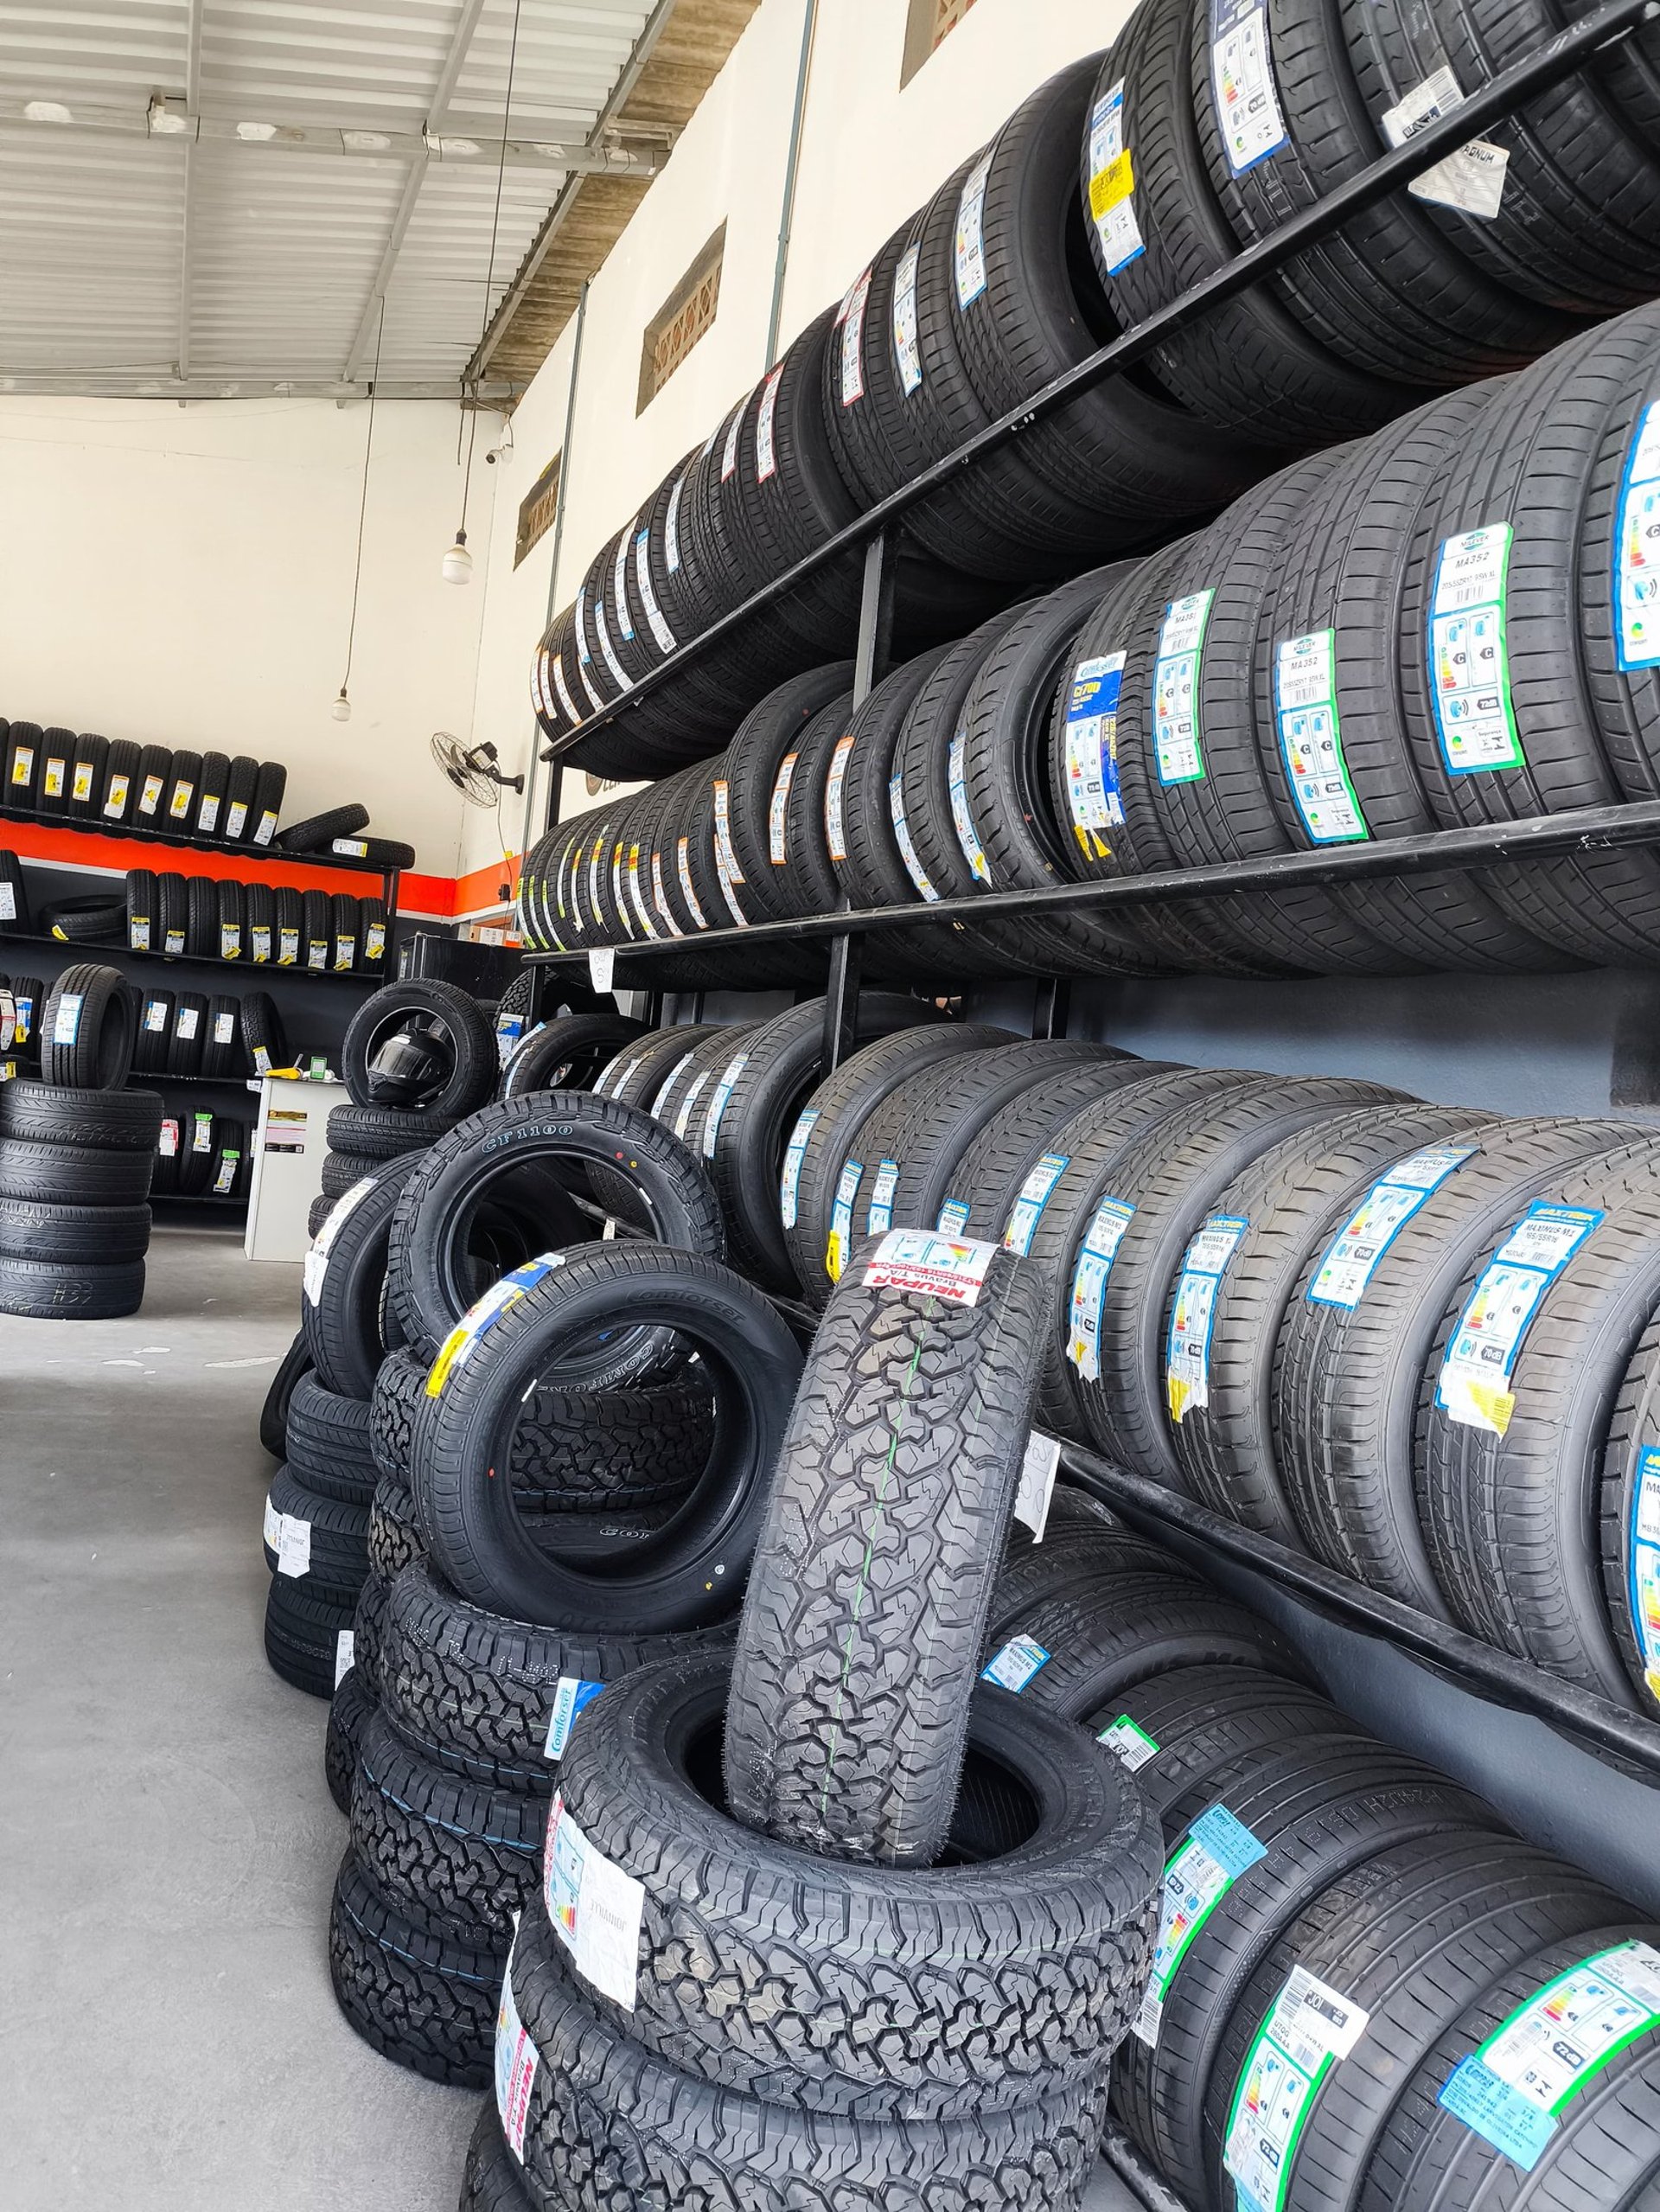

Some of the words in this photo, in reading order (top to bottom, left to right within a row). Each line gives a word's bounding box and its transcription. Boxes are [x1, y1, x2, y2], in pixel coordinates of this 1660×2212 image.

[1455, 552, 1490, 568] MA352
[1291, 657, 1318, 670] MA352
[482, 1124, 573, 1153] CF1100
[890, 1269, 910, 1278] T/A
[914, 1273, 956, 1287] Bravus
[872, 1275, 967, 1299] NEUPAR
[626, 1288, 748, 1326] Comforser
[552, 1689, 571, 1752] Comforser
[1307, 1991, 1325, 2011] JOI
[515, 2055, 534, 2152] NEUPAR
